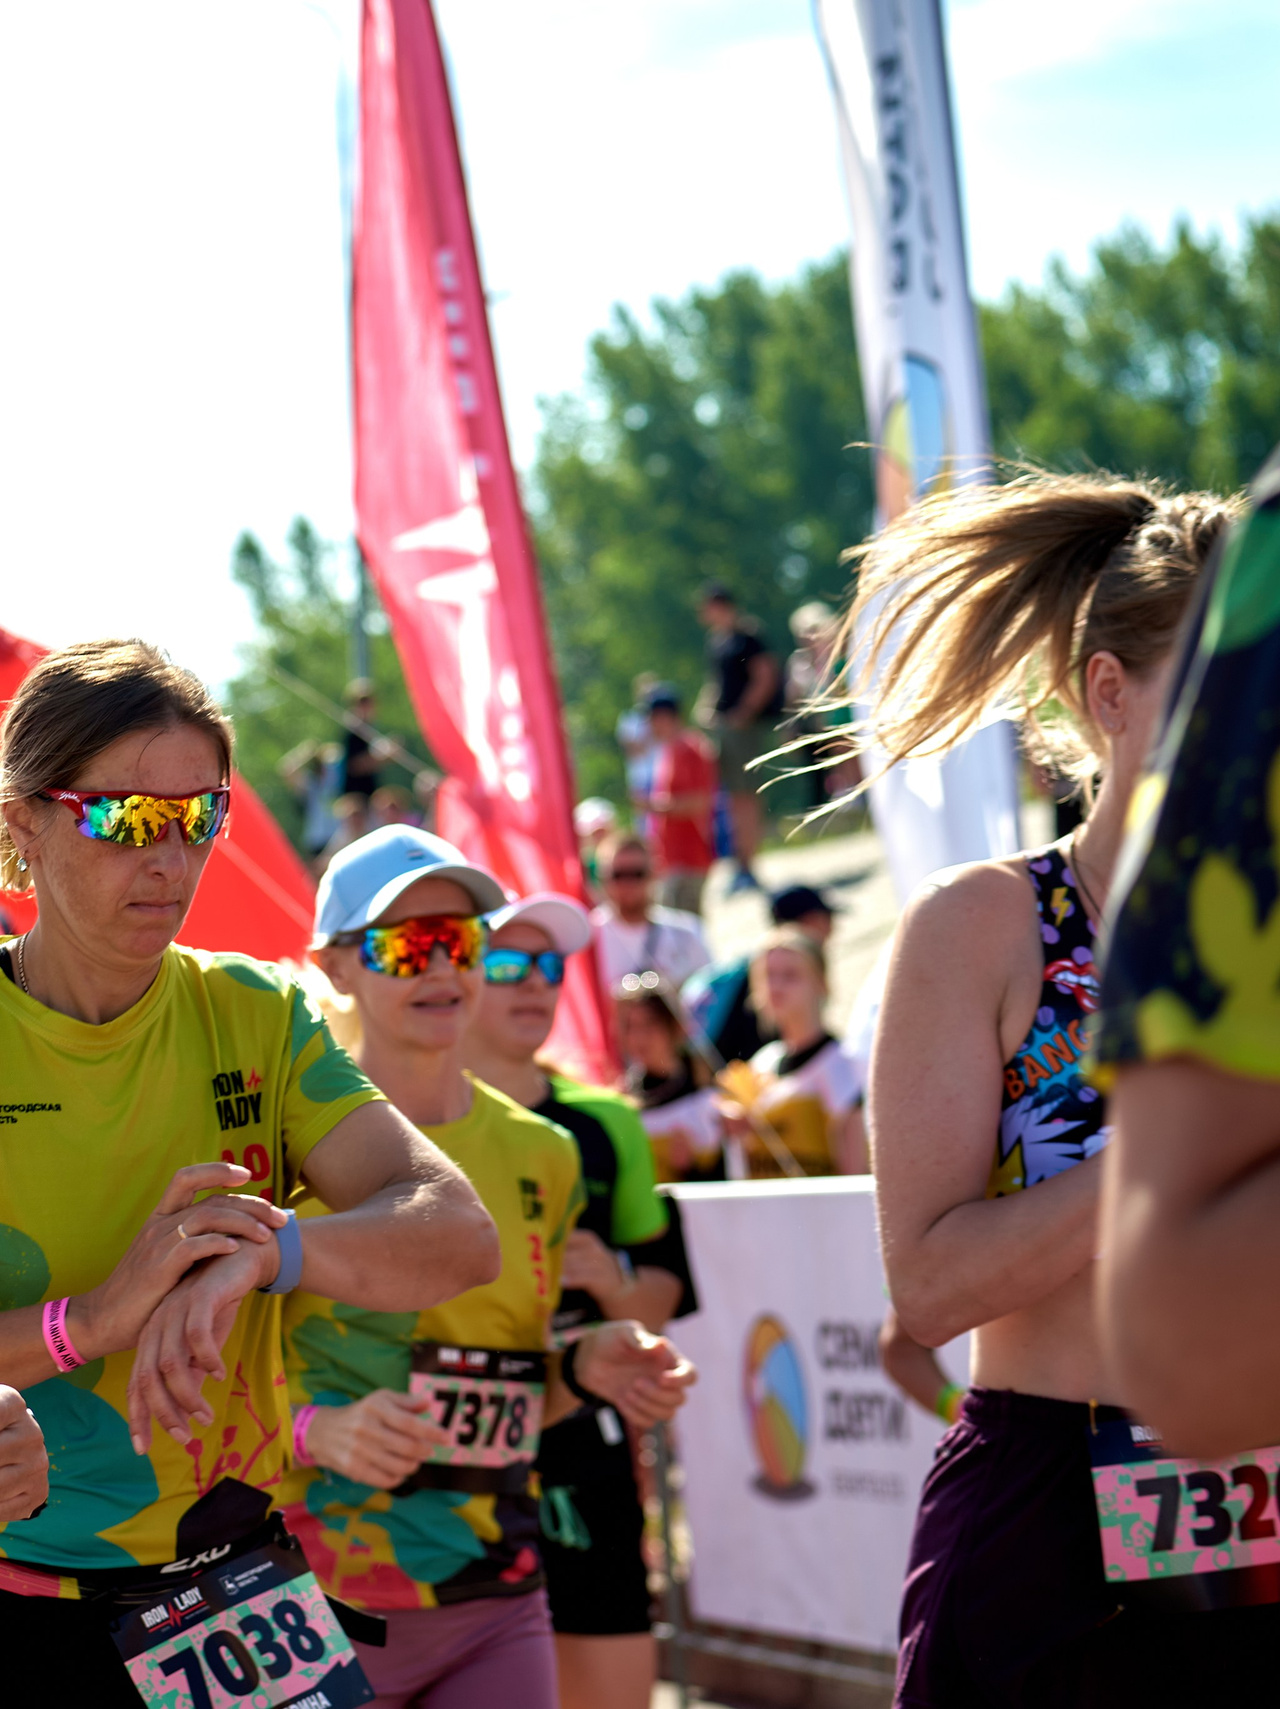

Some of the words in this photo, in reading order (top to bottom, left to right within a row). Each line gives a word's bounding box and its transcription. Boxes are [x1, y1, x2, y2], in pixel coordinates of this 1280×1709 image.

[1003, 1018, 1093, 1100] BANG
[435, 1389, 527, 1448] 7378
[1135, 1464, 1280, 1553] 732
[140, 1603, 170, 1629] IRON
[173, 1586, 204, 1611] LADY
[158, 1599, 325, 1709] 7038
